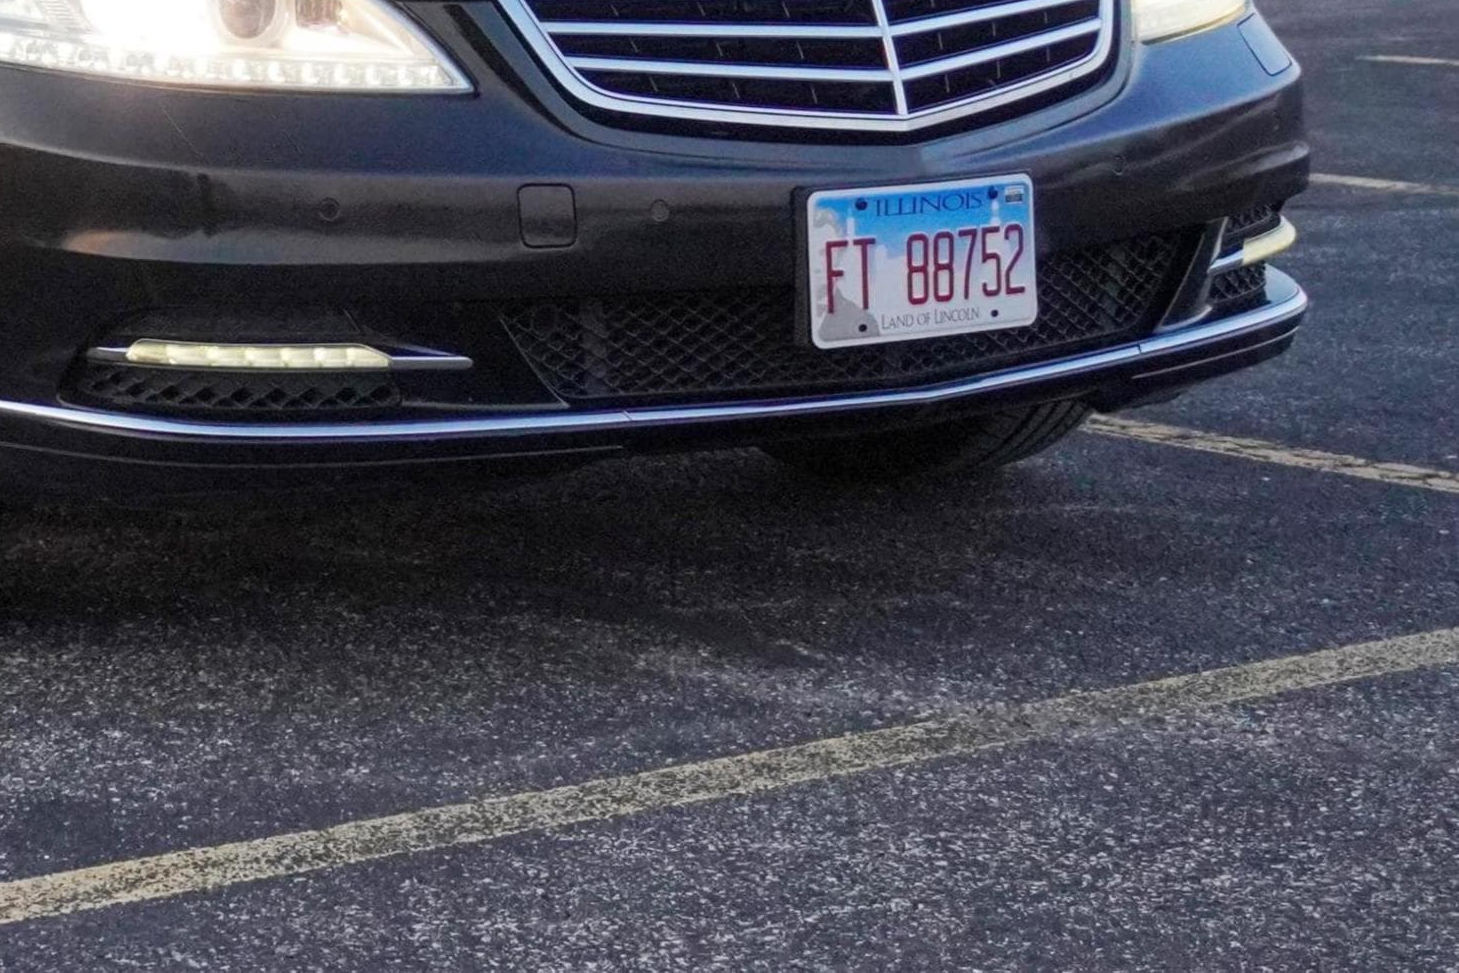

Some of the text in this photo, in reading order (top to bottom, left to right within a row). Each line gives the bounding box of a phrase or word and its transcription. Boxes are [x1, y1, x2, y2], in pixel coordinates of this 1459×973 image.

[875, 191, 983, 217] ILLINOIS
[825, 223, 1026, 314] FT 88752
[880, 307, 981, 330] LAND OF LINCOLN
